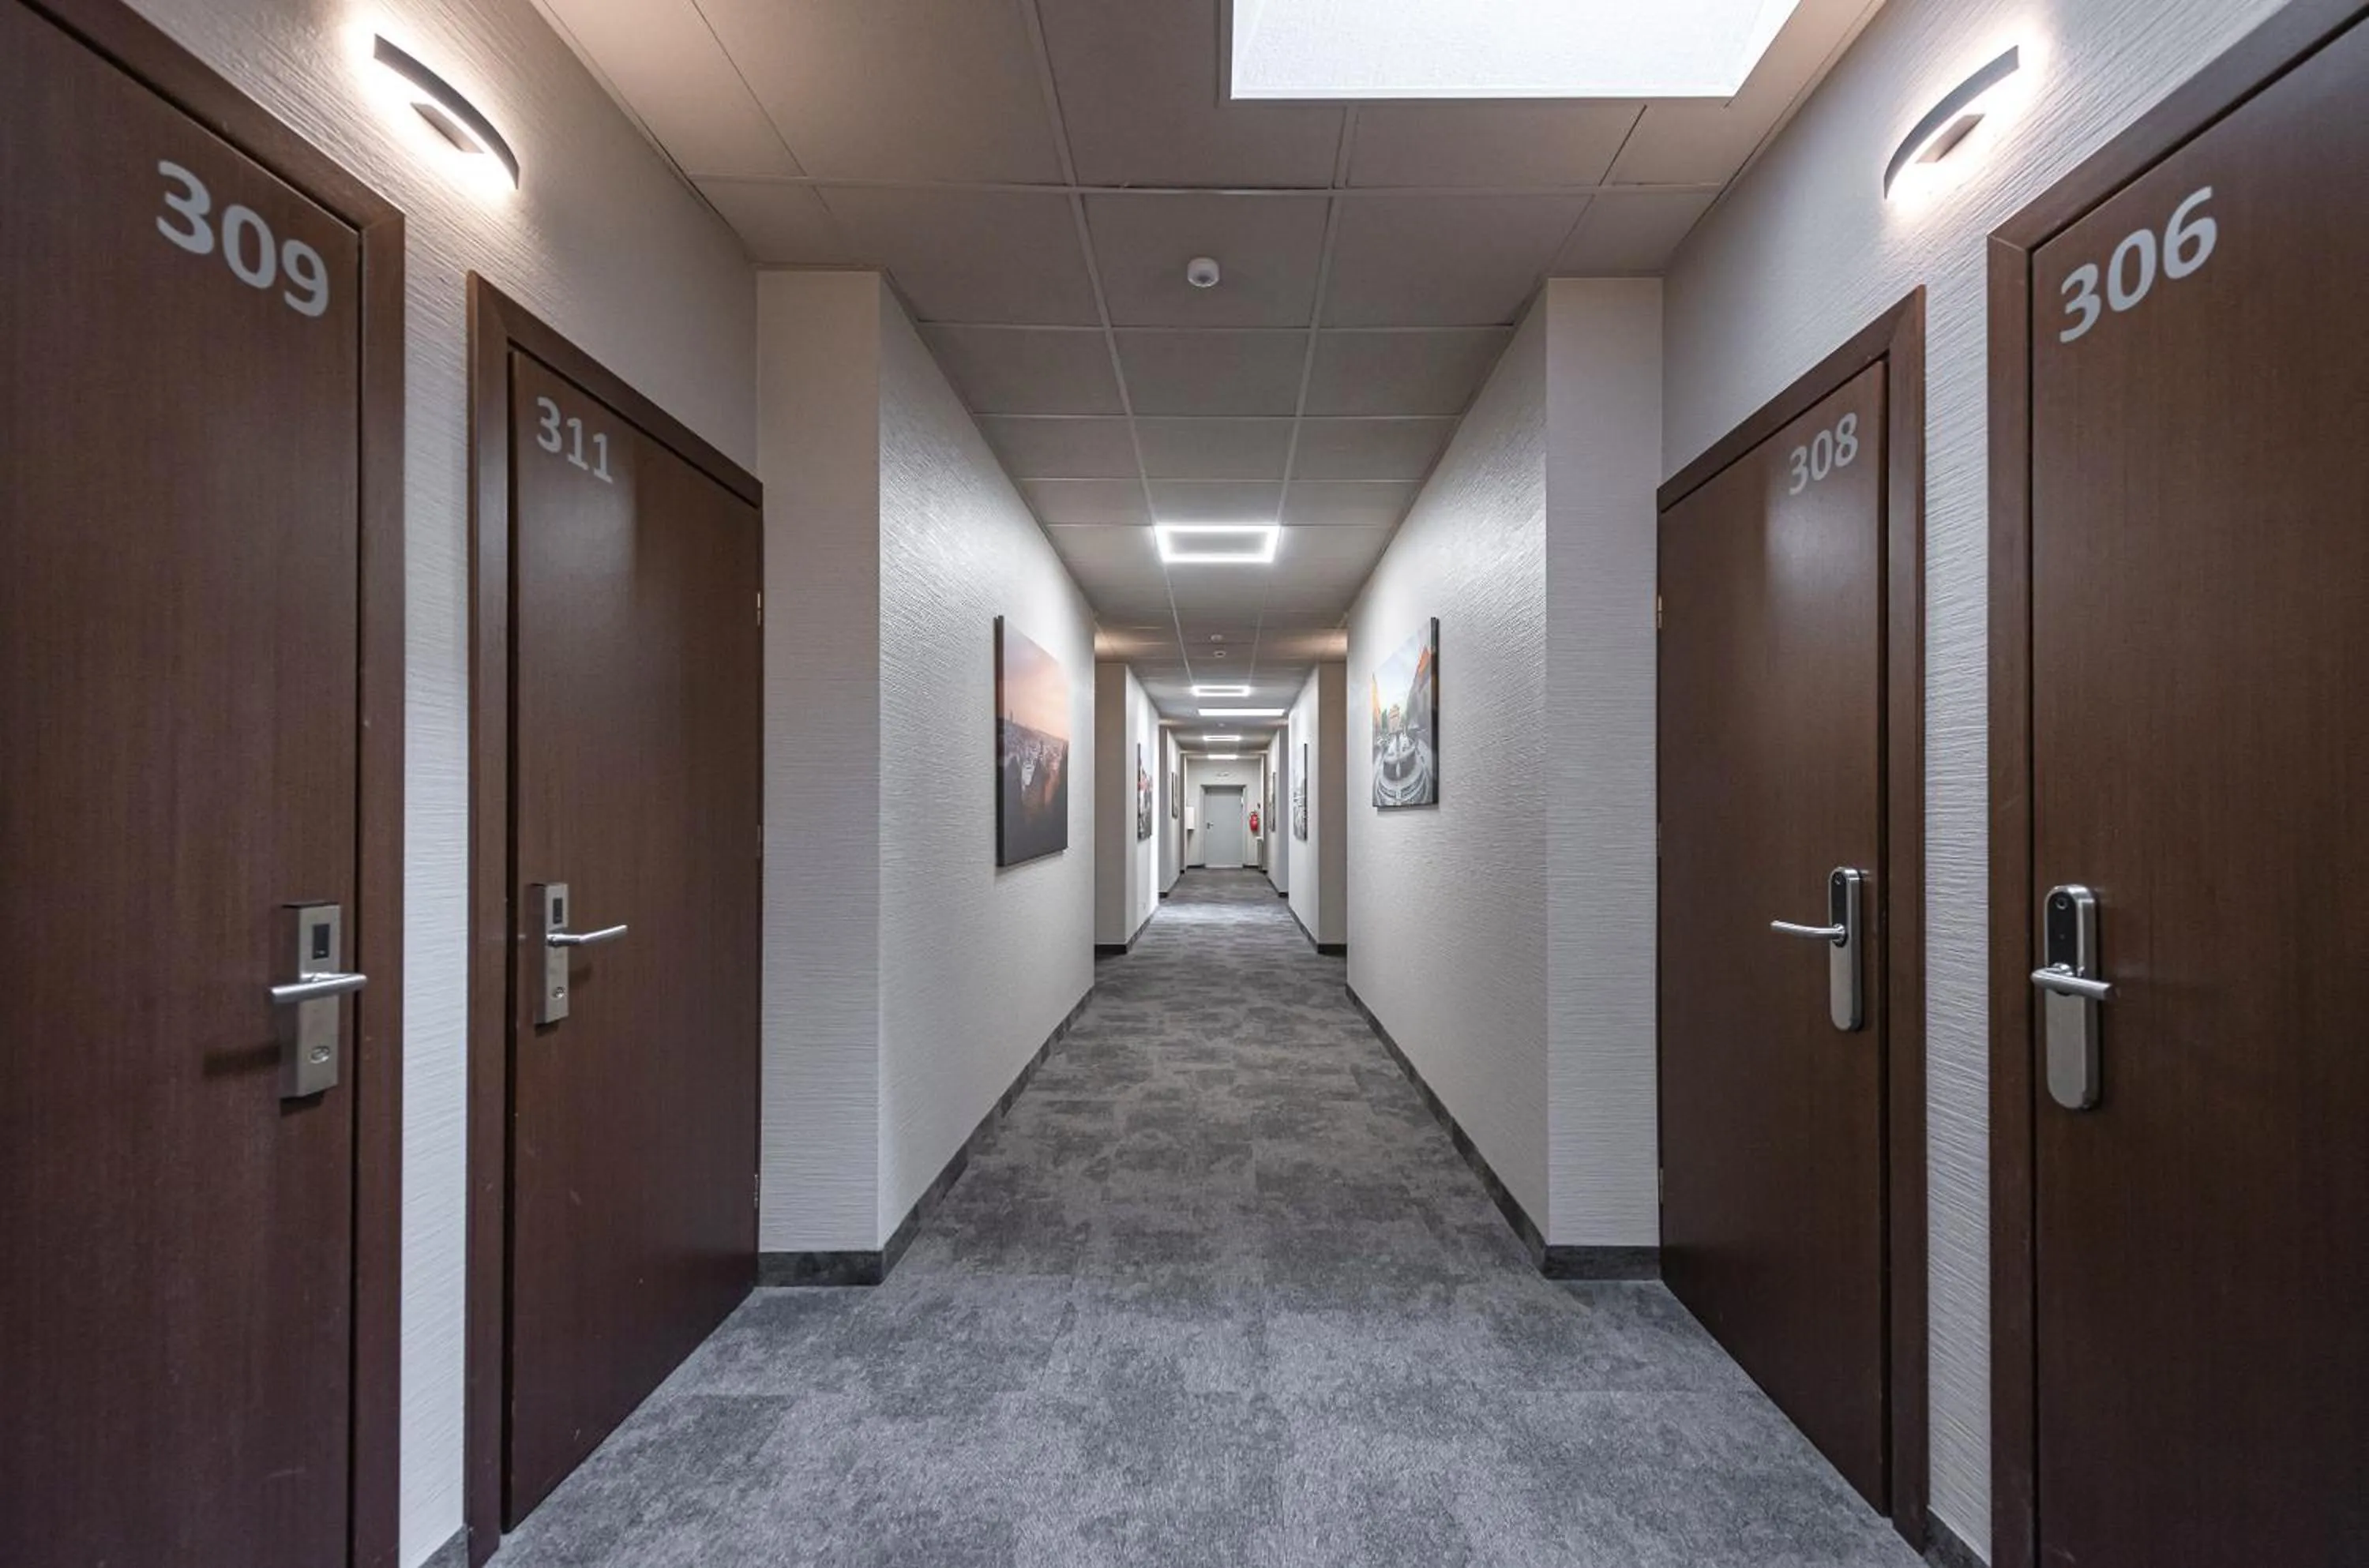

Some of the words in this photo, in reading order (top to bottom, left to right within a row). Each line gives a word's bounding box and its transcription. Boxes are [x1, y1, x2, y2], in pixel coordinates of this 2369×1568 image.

[156, 160, 329, 317] 309
[2059, 186, 2217, 343] 306
[537, 397, 614, 483] 311
[1789, 413, 1858, 495] 308
